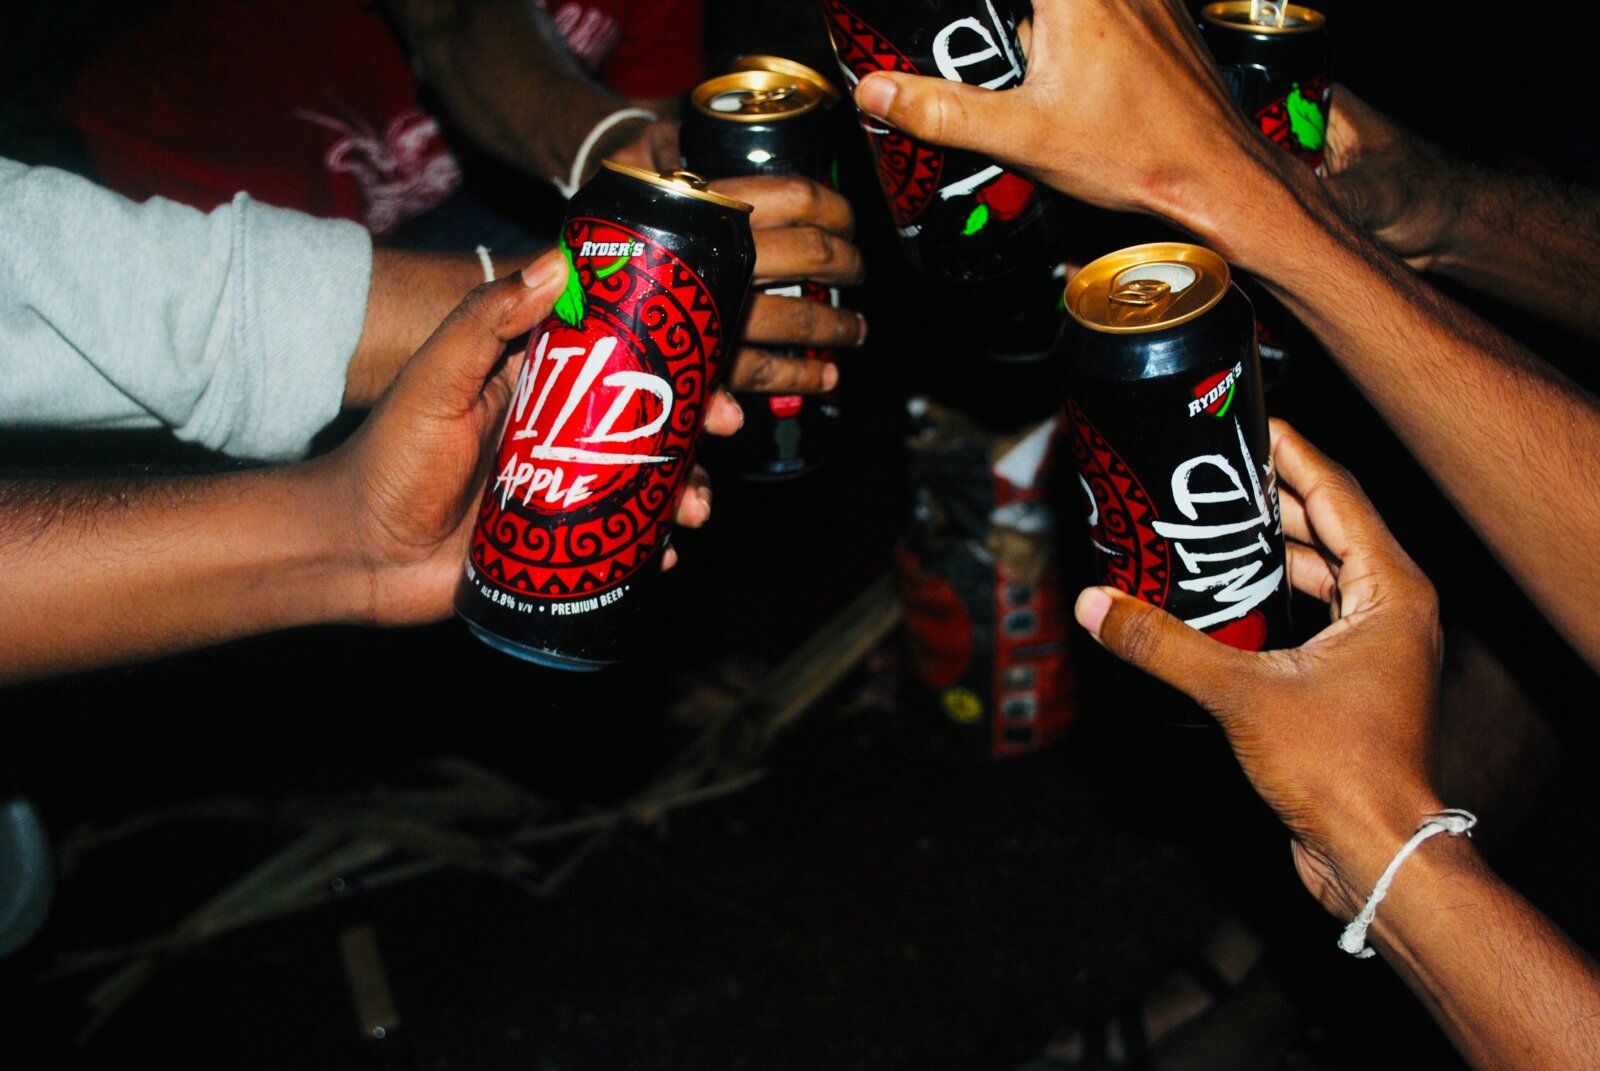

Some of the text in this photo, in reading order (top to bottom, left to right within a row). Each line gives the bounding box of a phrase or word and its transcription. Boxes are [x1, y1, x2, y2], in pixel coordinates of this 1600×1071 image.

[580, 241, 645, 257] RYDER'S
[1187, 360, 1243, 418] RYDER'S
[493, 452, 599, 511] APPLE
[1152, 414, 1284, 630] WILD
[480, 584, 492, 599] ALC
[491, 589, 516, 610] 8.8%
[551, 597, 599, 616] PREMIUM
[600, 586, 625, 607] BEER
